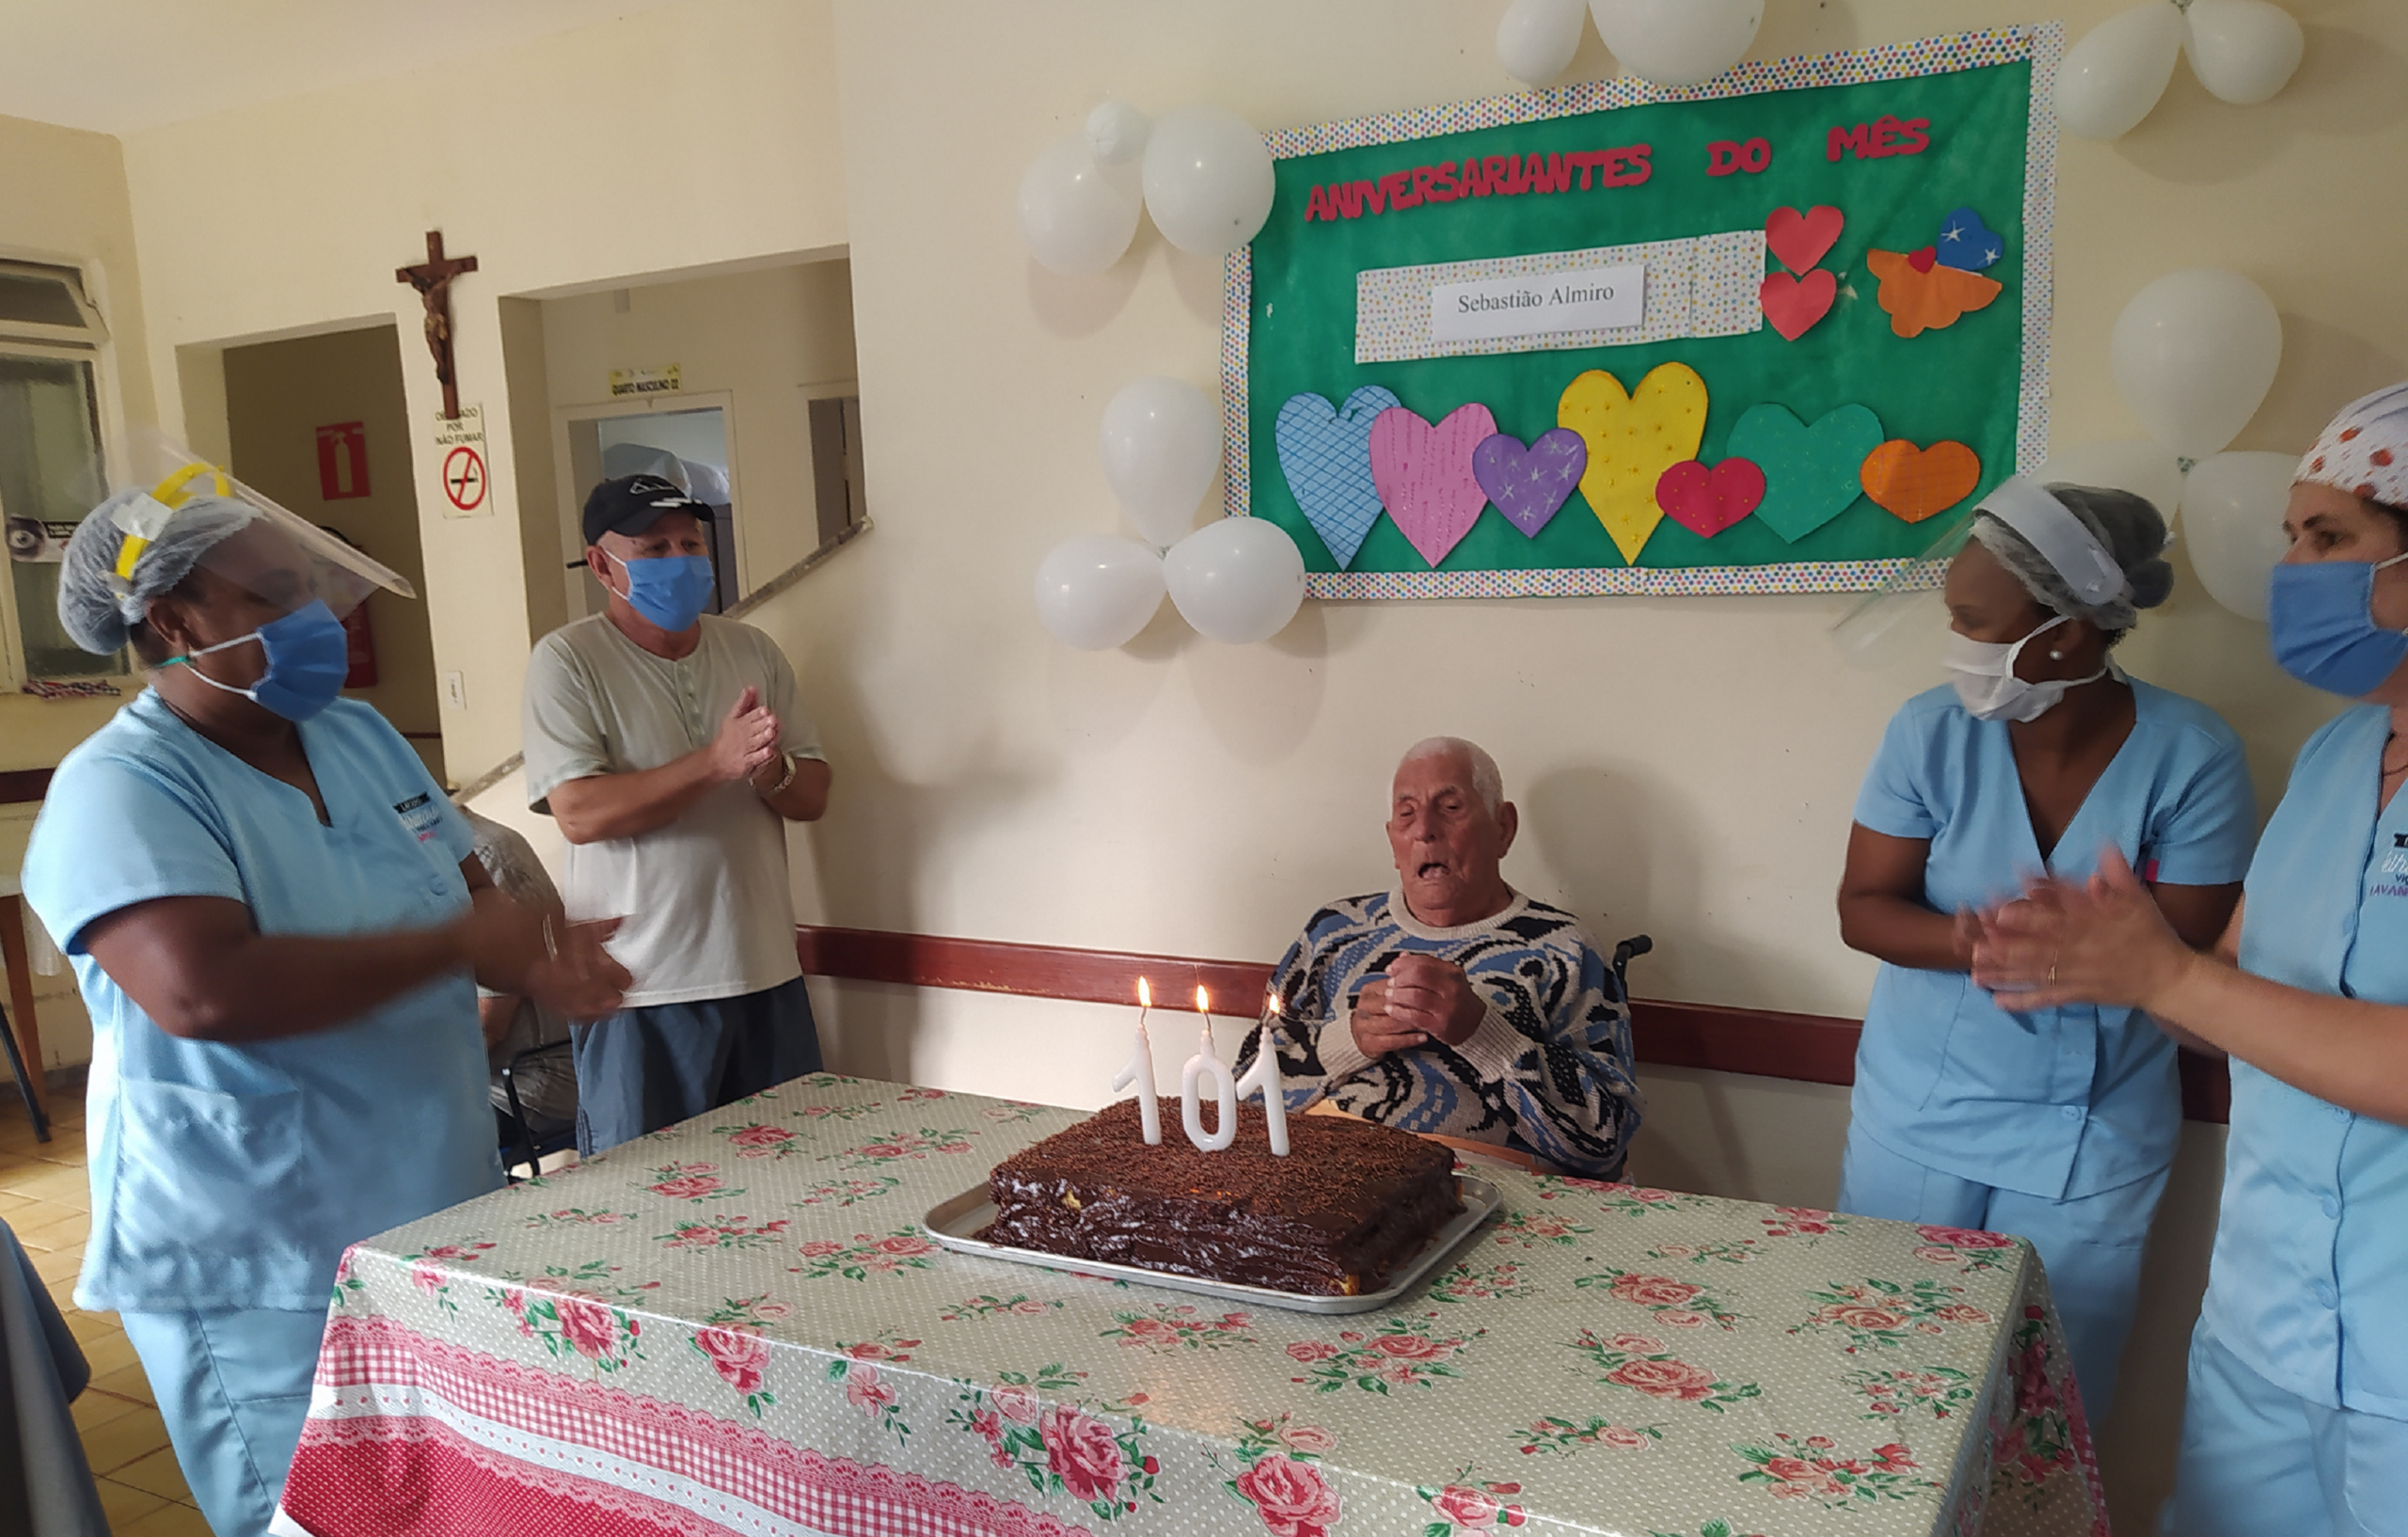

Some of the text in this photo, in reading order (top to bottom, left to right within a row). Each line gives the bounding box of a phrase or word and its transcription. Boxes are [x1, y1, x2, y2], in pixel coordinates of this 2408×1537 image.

[1304, 114, 1930, 223] ANIVERSARIANTES DO MÊS
[1458, 283, 1615, 313] Sebastião Almiro
[446, 421, 465, 432] POR
[454, 432, 484, 444] FUMAR
[1112, 1023, 1291, 1158] 101
